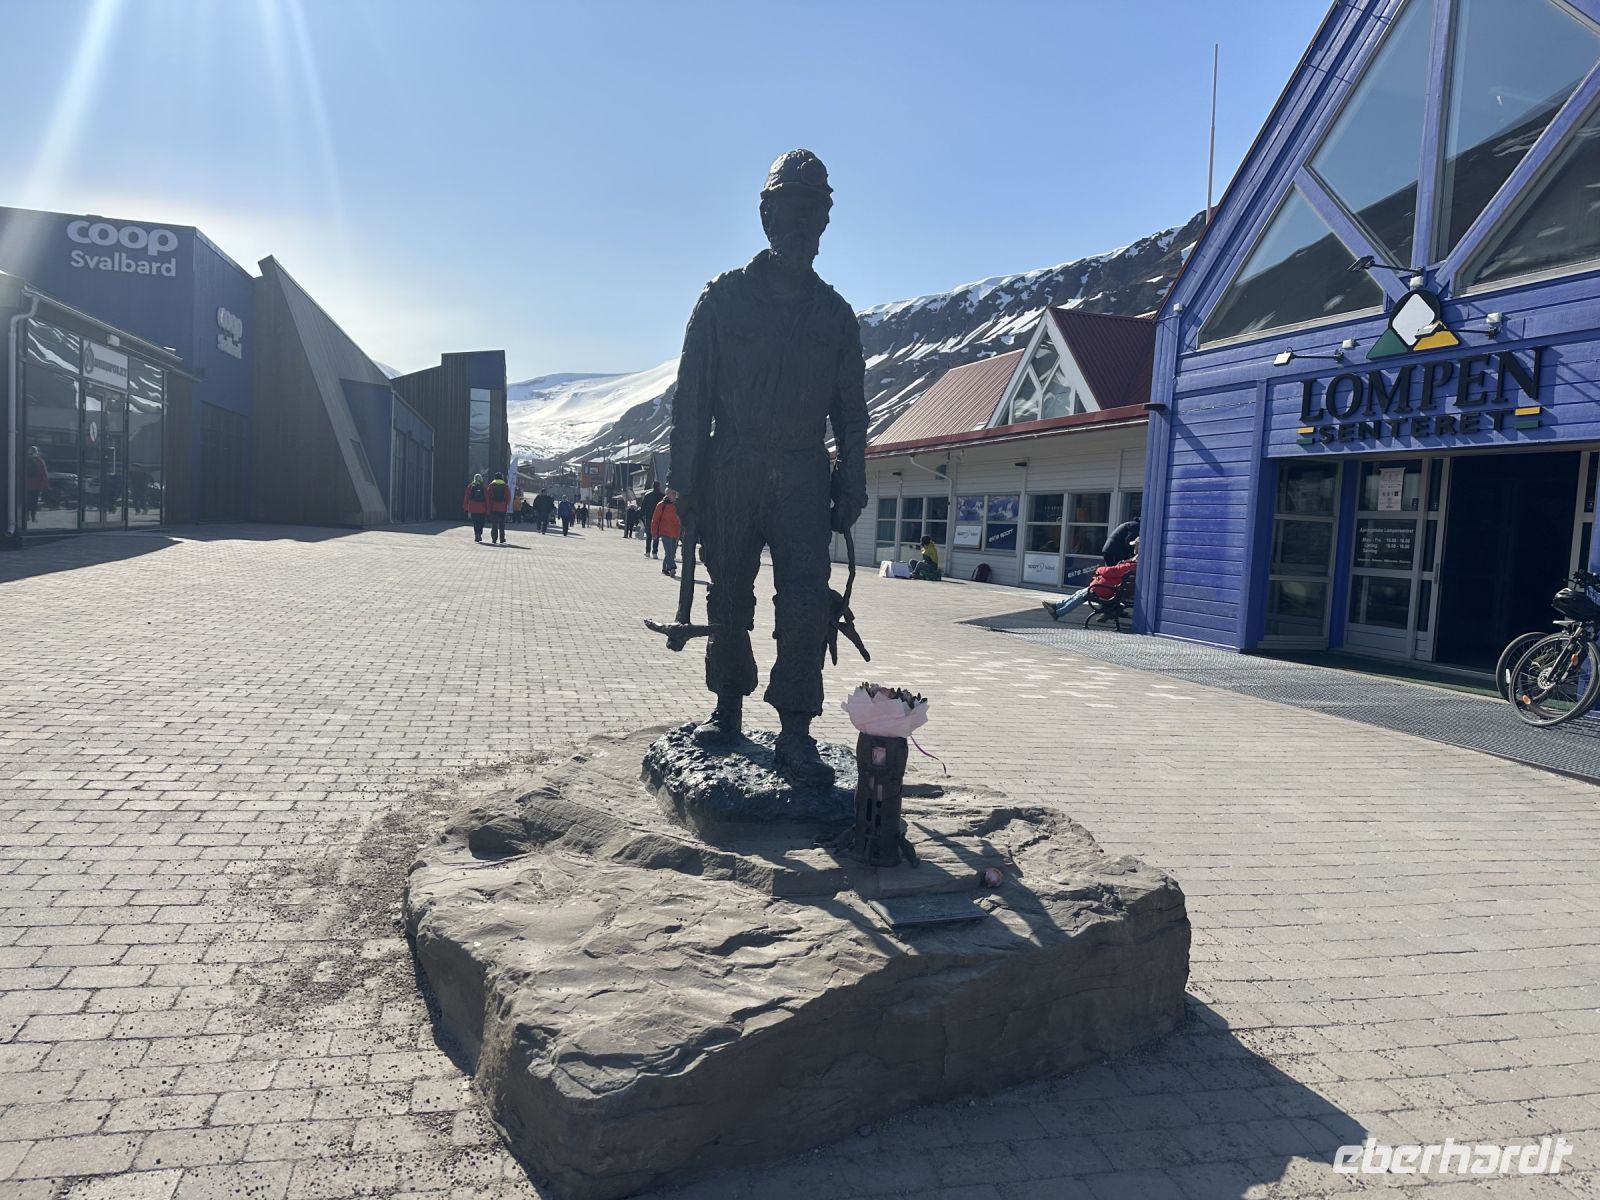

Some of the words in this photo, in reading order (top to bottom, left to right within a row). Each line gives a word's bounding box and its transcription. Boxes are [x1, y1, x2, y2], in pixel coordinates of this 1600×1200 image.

[66, 220, 179, 256] coop
[70, 250, 176, 277] Svalbard
[1299, 347, 1547, 422] LOMPEN
[1318, 409, 1508, 444] SENTERET
